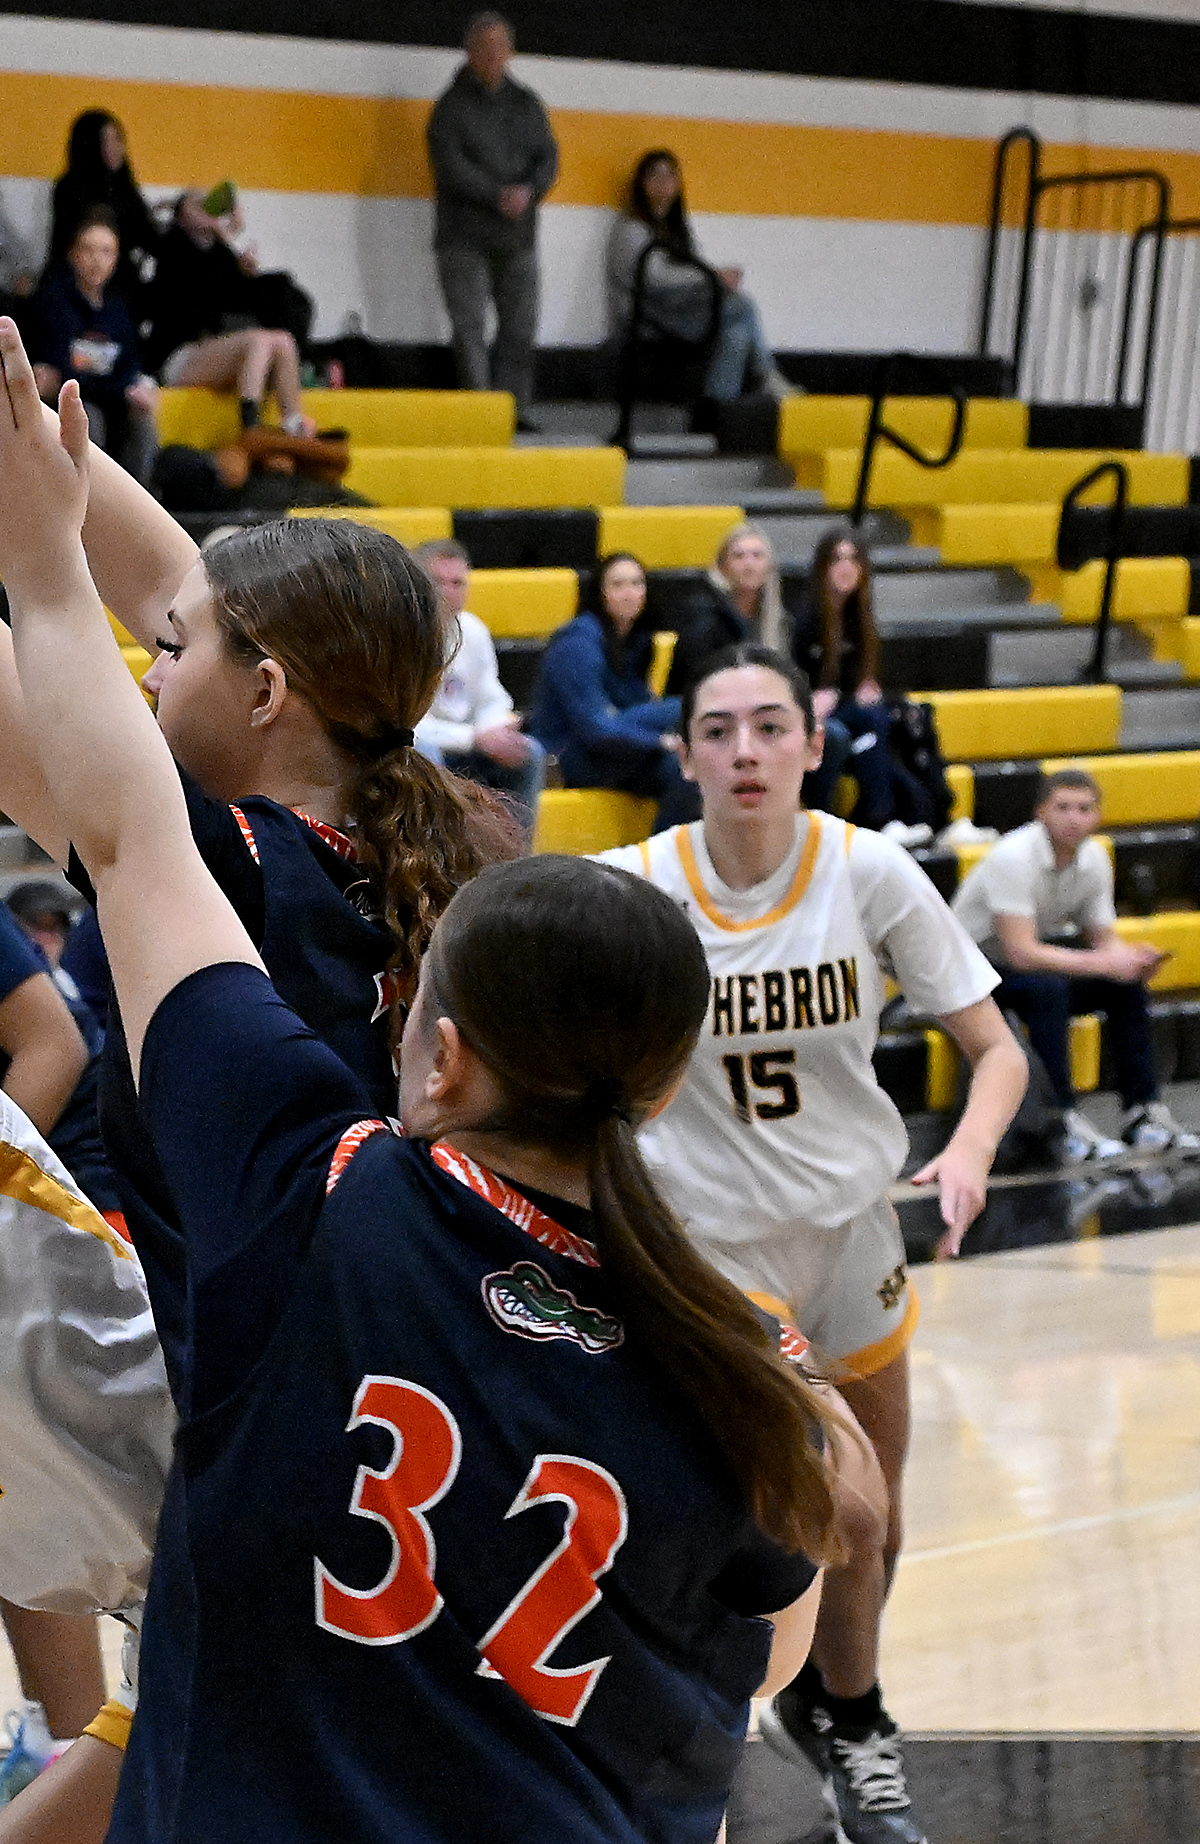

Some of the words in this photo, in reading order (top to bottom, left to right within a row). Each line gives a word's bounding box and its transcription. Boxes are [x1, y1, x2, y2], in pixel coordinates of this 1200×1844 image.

[711, 956, 861, 1037] HEBRON
[721, 1049, 801, 1125] 15
[313, 1363, 629, 1728] 32
